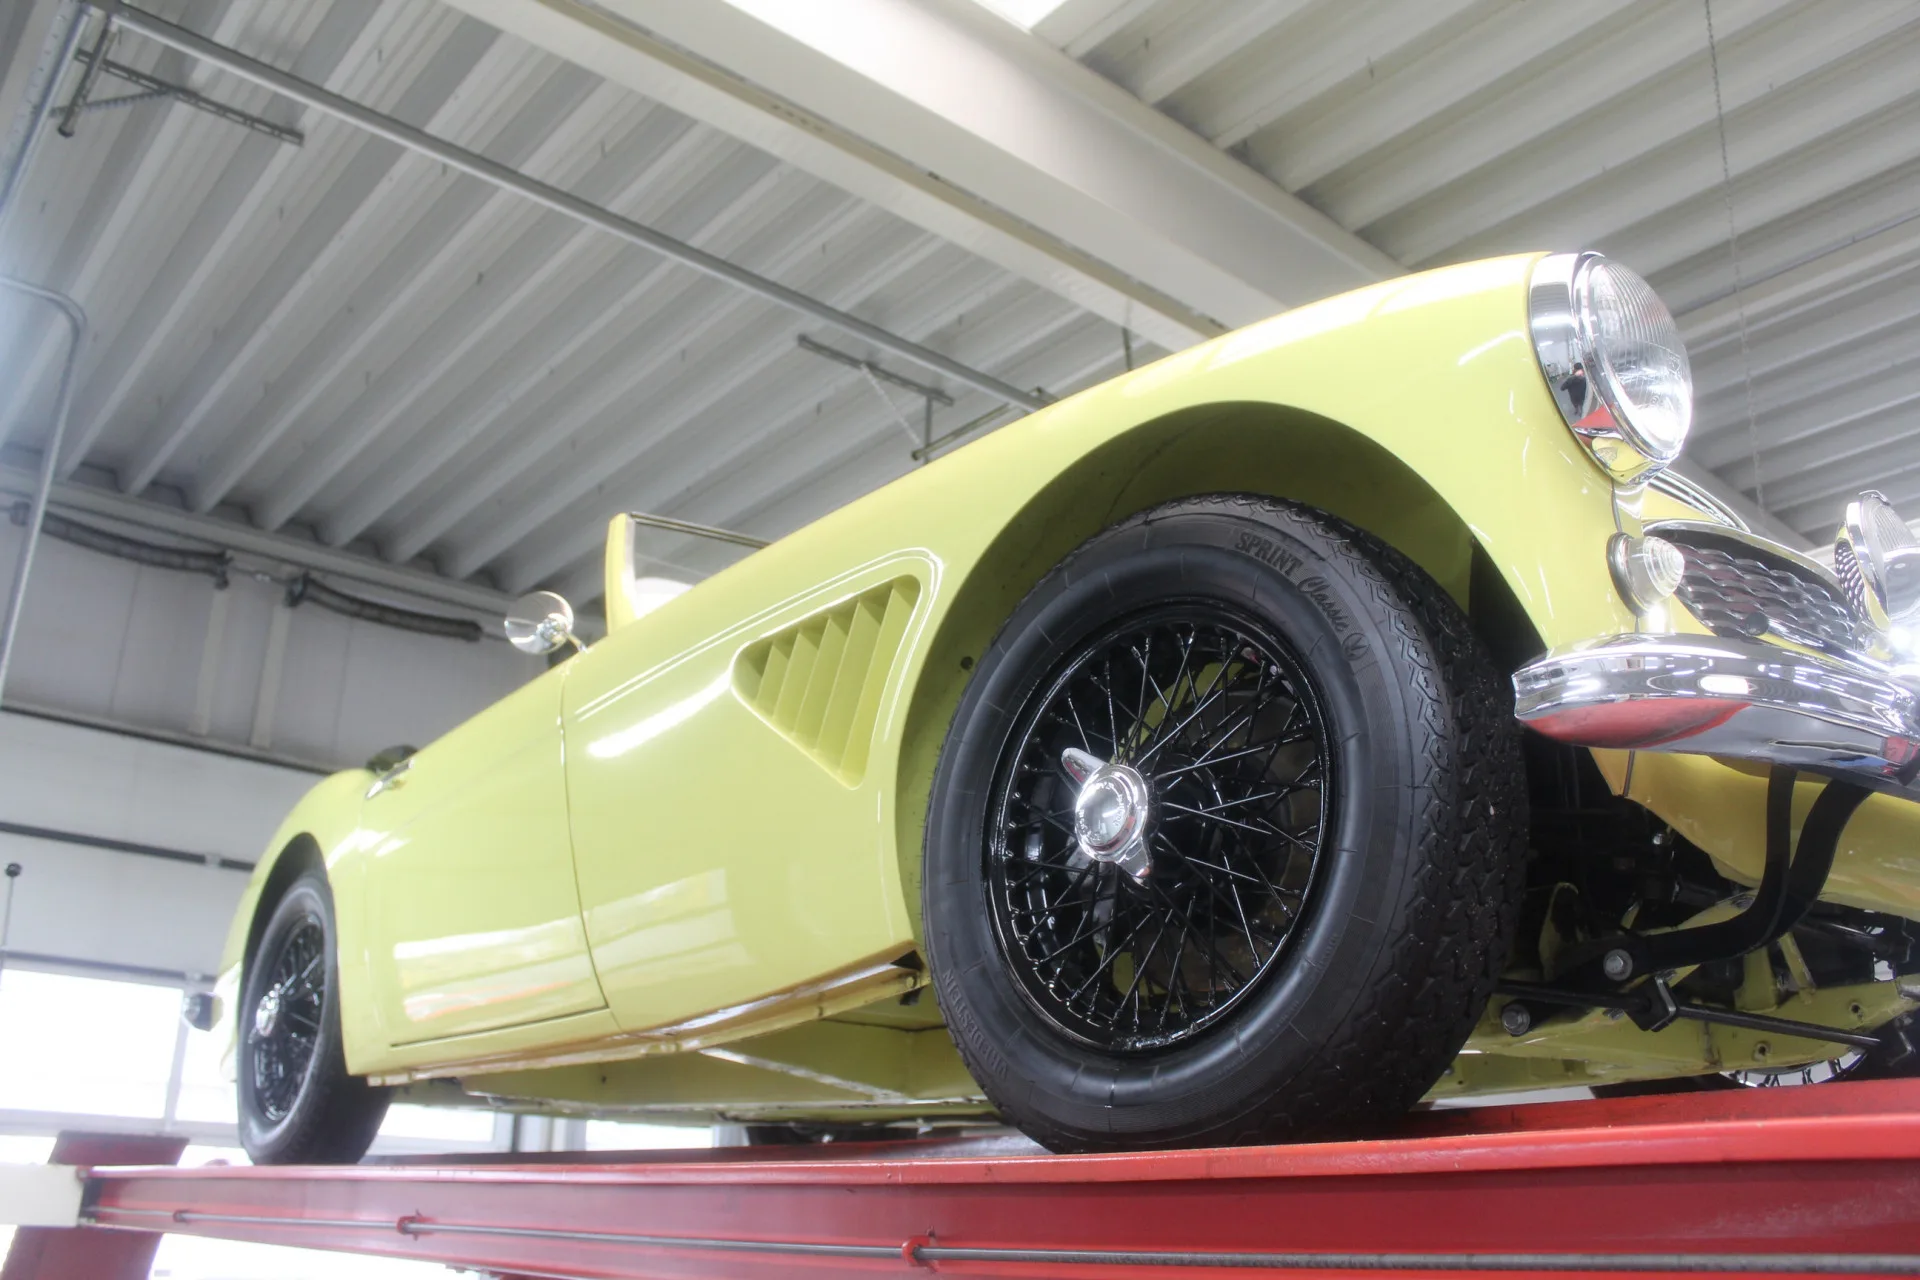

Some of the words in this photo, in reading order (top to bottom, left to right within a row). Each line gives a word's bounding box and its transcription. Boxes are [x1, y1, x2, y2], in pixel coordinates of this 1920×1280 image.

[1234, 531, 1304, 577] SPRINT
[1297, 575, 1350, 632] Classic
[942, 967, 1009, 1080] VREDESTEIN
